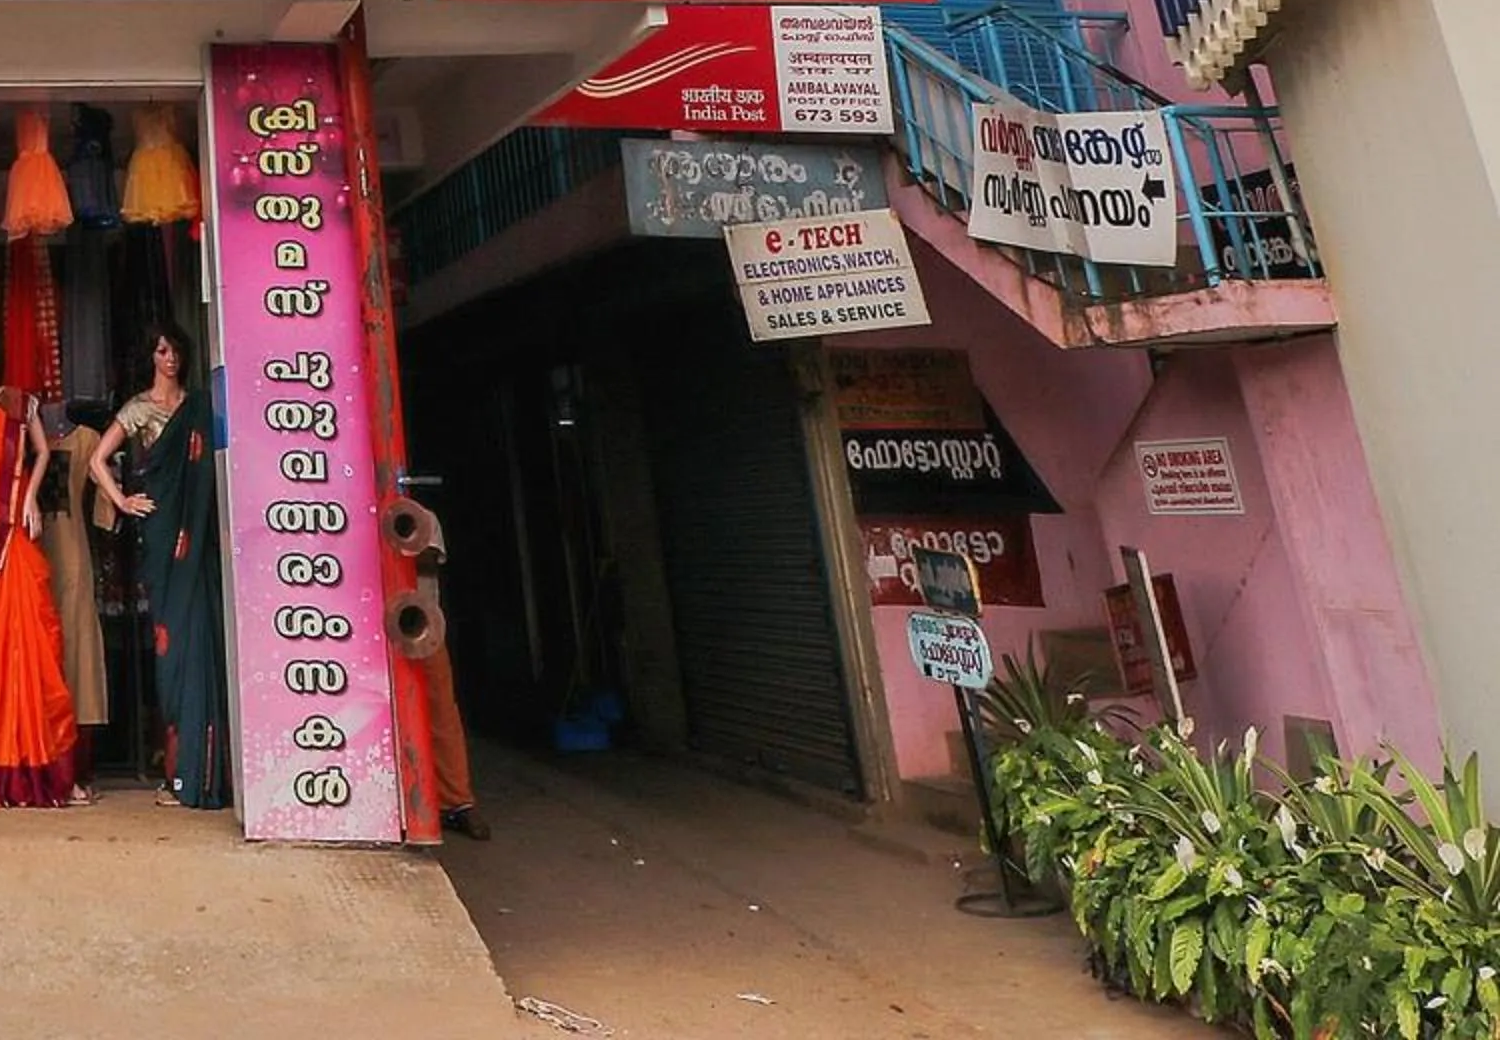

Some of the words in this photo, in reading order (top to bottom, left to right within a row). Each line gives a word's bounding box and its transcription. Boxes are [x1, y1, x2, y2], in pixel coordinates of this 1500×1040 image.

[787, 81, 880, 95] AMBALAVAYAL
[788, 97, 826, 105] POST
[830, 97, 882, 105] OFFICE
[684, 105, 727, 121] India
[730, 105, 766, 121] Post
[795, 109, 832, 123] 673
[840, 109, 878, 123] 593
[757, 289, 769, 307] &
[771, 285, 814, 305] HOME
[817, 276, 906, 301] APPLIANCES
[767, 311, 817, 330] SALES
[821, 309, 834, 326] &
[837, 302, 906, 323] SERVICE
